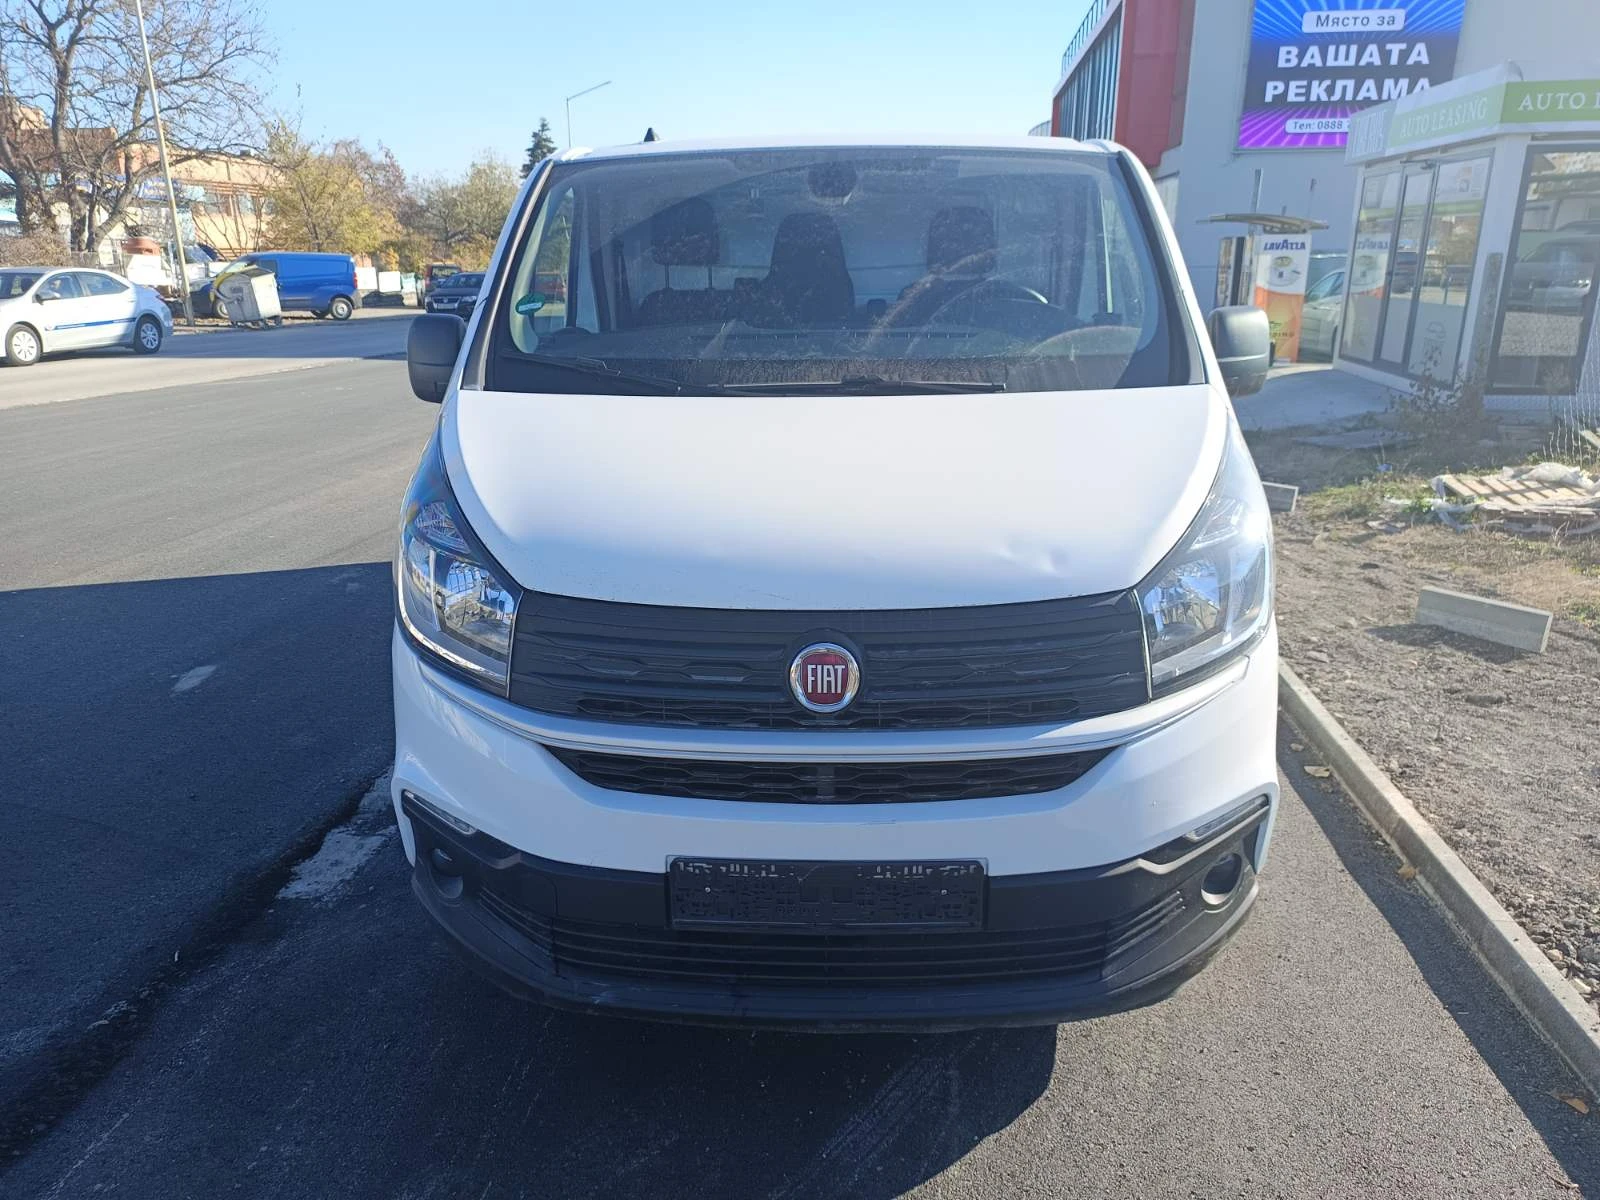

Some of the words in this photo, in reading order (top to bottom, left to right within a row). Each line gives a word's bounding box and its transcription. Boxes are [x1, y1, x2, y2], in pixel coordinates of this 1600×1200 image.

[1315, 14, 1371, 28] Място
[1376, 16, 1396, 27] за
[1277, 42, 1430, 68] ВАШАТА
[1517, 91, 1586, 111] AUTO
[1317, 120, 1343, 130] 0888
[1400, 112, 1430, 138] AUTO
[1431, 95, 1488, 132] LEASING
[1263, 238, 1306, 251] LAVAZZA
[807, 664, 846, 694] FIAT
